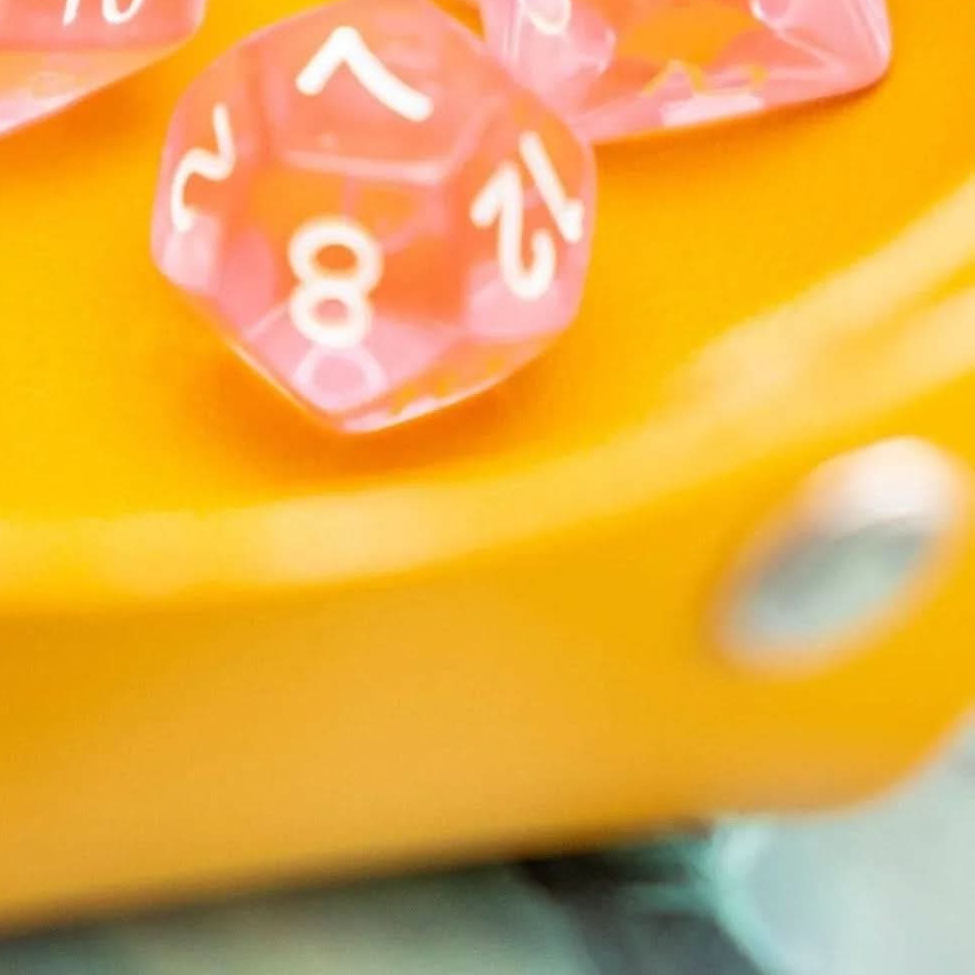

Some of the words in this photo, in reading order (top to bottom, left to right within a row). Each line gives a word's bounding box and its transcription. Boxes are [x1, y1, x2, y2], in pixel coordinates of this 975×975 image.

[294, 26, 434, 122] 7
[169, 102, 236, 232] 2
[469, 131, 584, 299] 12
[287, 216, 386, 347] 8
